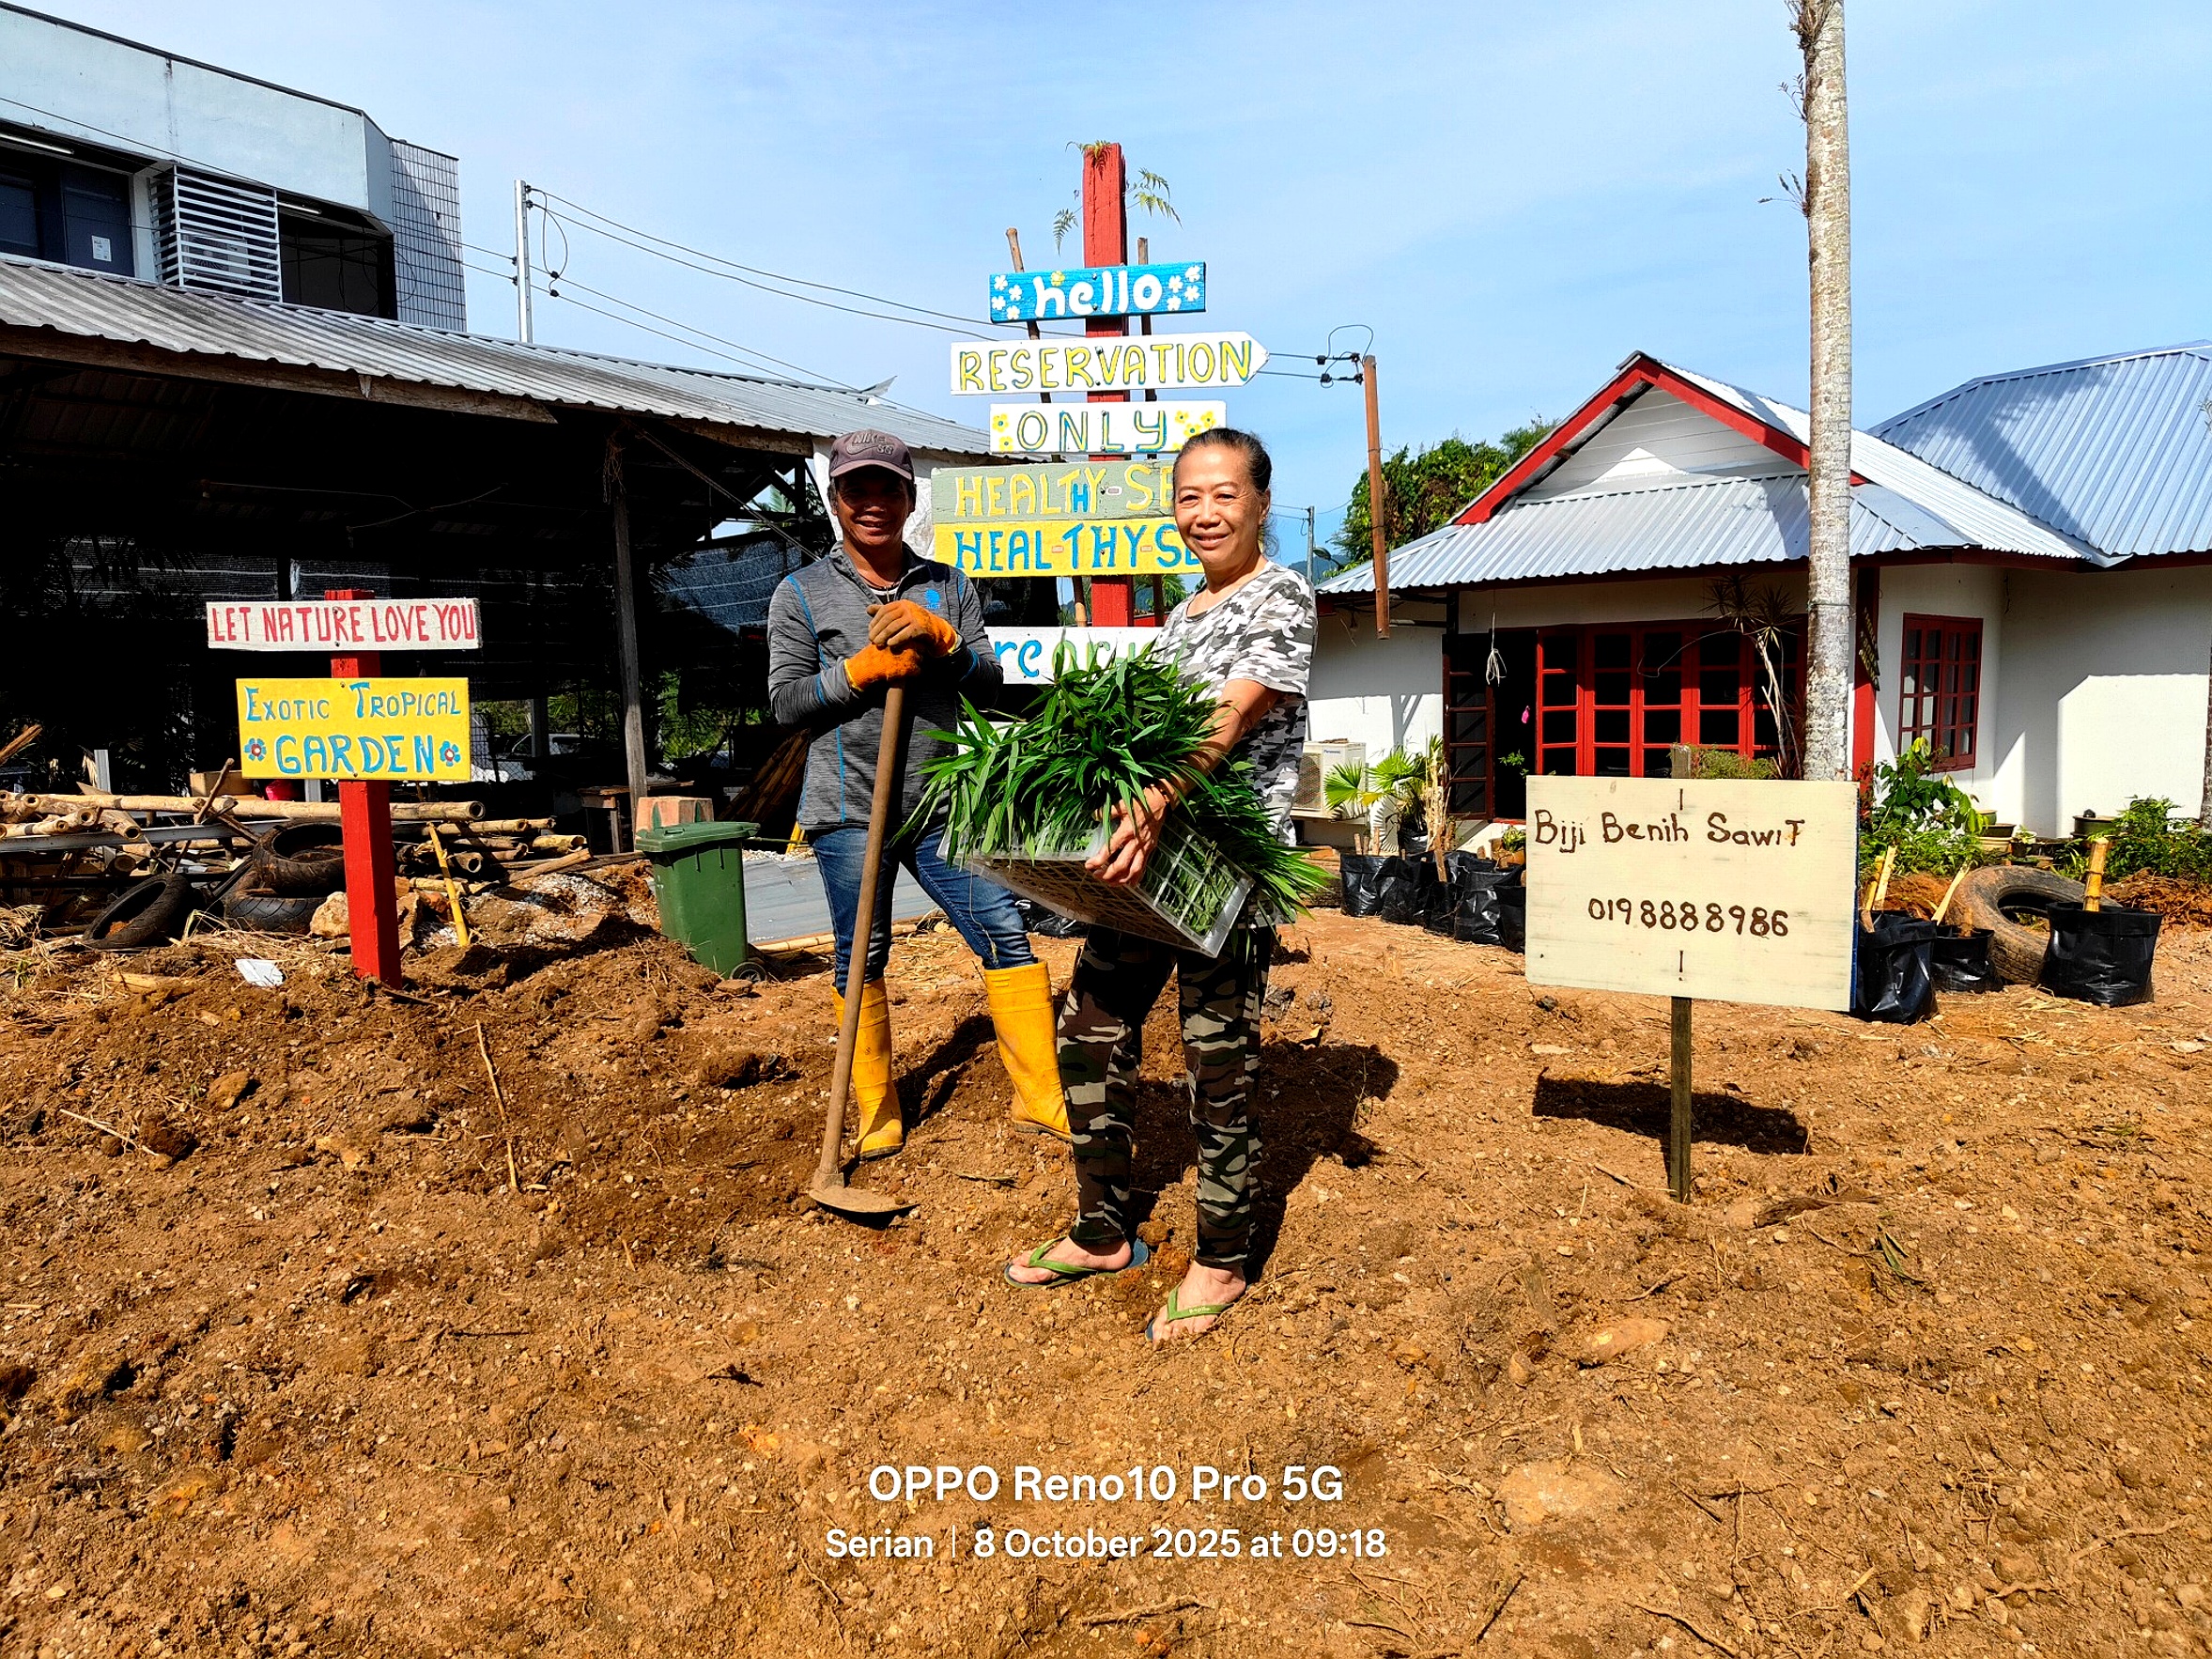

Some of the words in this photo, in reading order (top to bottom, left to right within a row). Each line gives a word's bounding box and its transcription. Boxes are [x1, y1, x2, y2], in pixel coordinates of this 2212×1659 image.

[1032, 270, 1163, 318] hello
[959, 340, 1252, 391] RESERVATION
[1016, 411, 1167, 451] ONLY
[211, 607, 251, 642] LET
[262, 606, 364, 643] NATURE
[372, 604, 430, 642] LOVE
[432, 603, 475, 641] YOU
[276, 735, 434, 774] GARDEN
[1535, 809, 1586, 853] Biji
[1601, 811, 1688, 843] Benih
[1587, 898, 1788, 938] 0198888986
